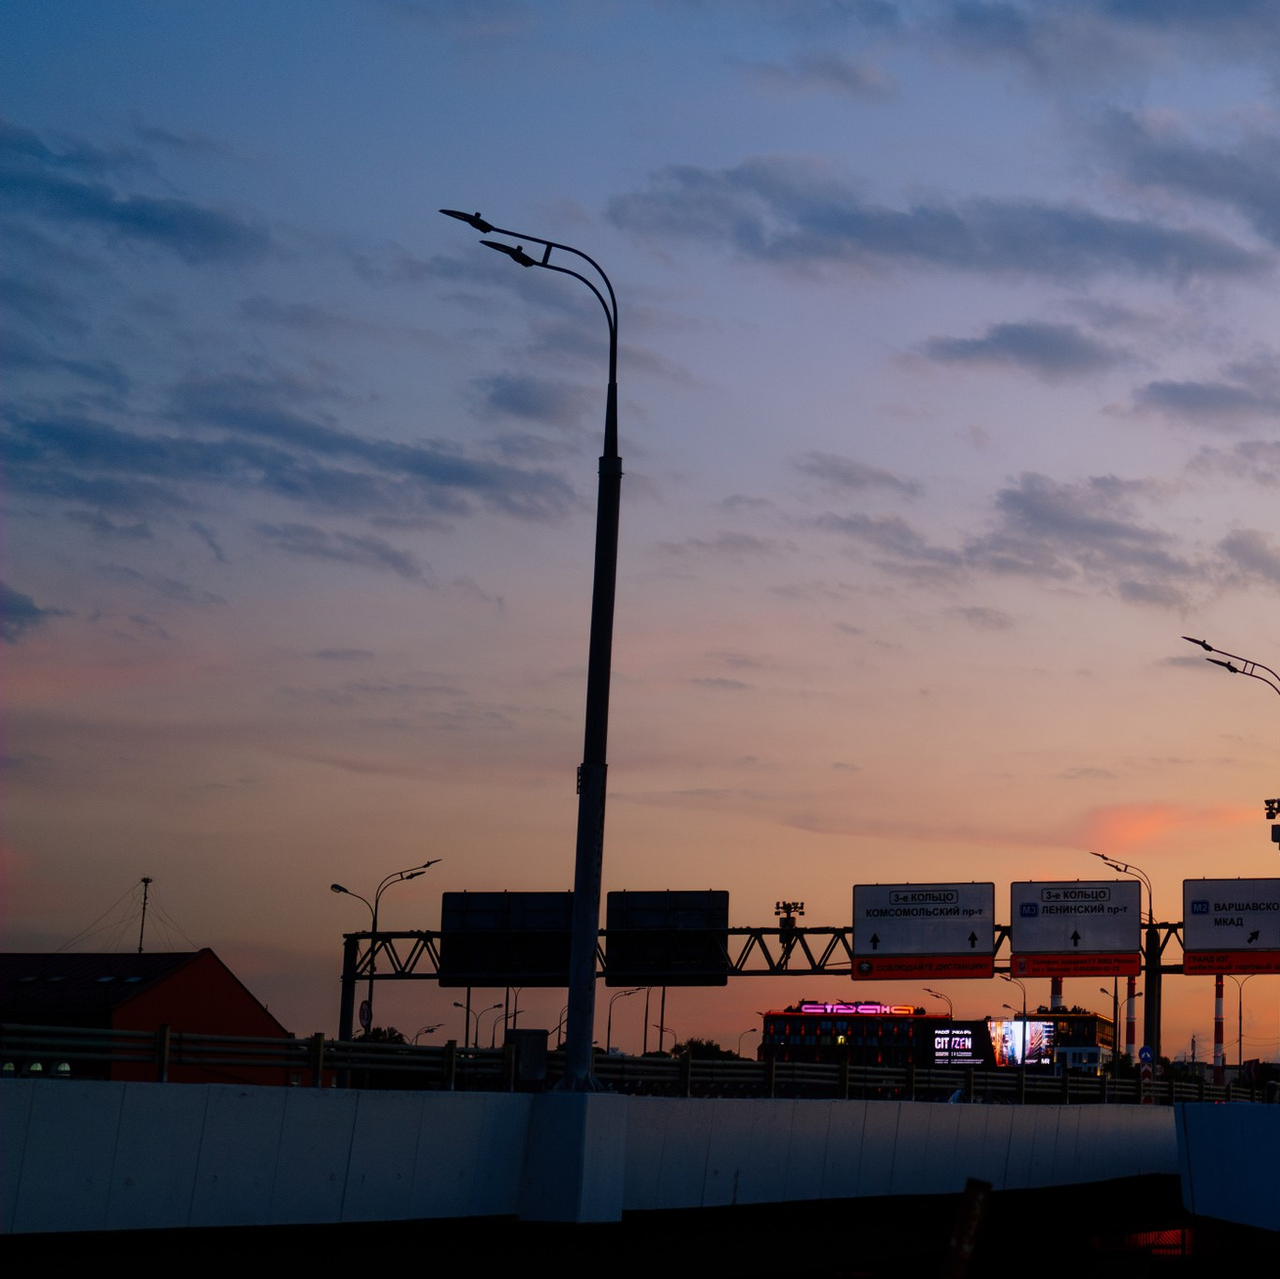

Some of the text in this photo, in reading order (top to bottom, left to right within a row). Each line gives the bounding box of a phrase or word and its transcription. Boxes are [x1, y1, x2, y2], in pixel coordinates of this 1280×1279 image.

[893, 892, 954, 904] 3-е КОЛЬЦО
[1046, 890, 1107, 900] 3-е КОЛЬЦО
[866, 906, 983, 918] КОМСОМОЛЬСКИЙ пр-т
[1041, 904, 1128, 915] ЛЕНИНСКИЙ пр-т
[1214, 918, 1244, 927] МКАД
